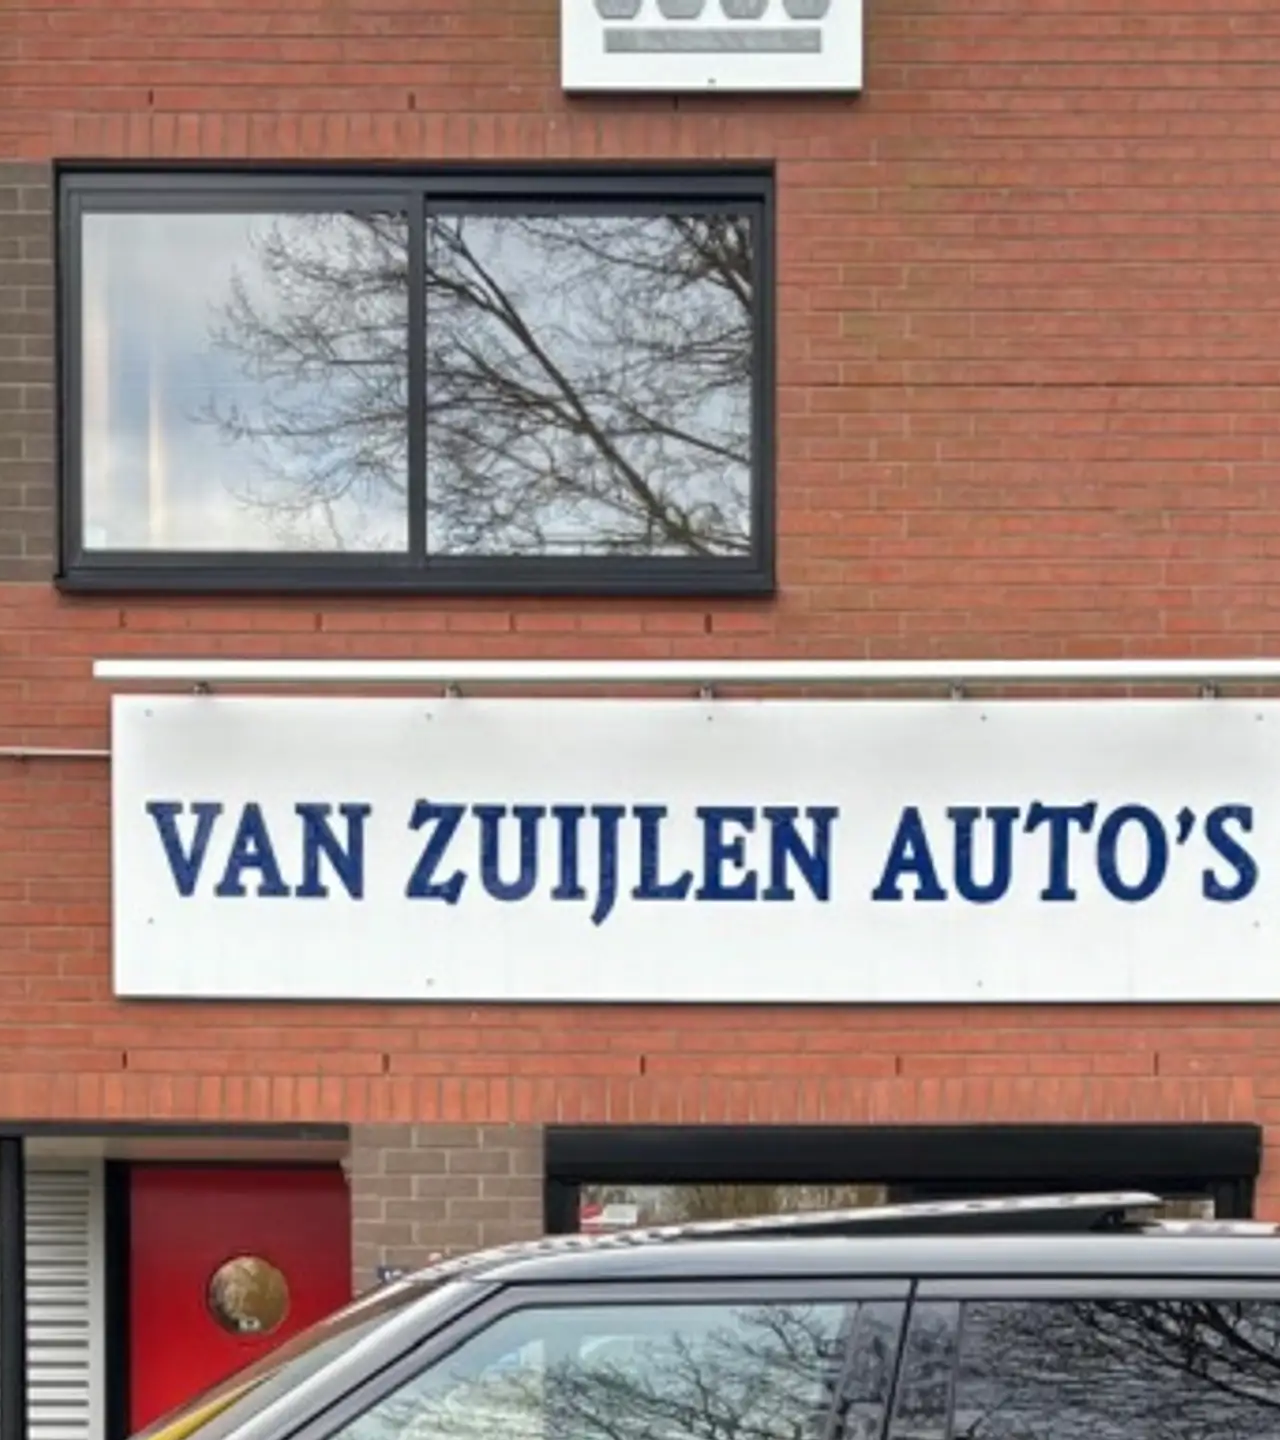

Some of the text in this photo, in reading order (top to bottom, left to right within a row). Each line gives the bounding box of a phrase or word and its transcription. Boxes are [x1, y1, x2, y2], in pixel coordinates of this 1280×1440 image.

[146, 797, 1261, 927] VAN ZUIJLEN AUTO'S
